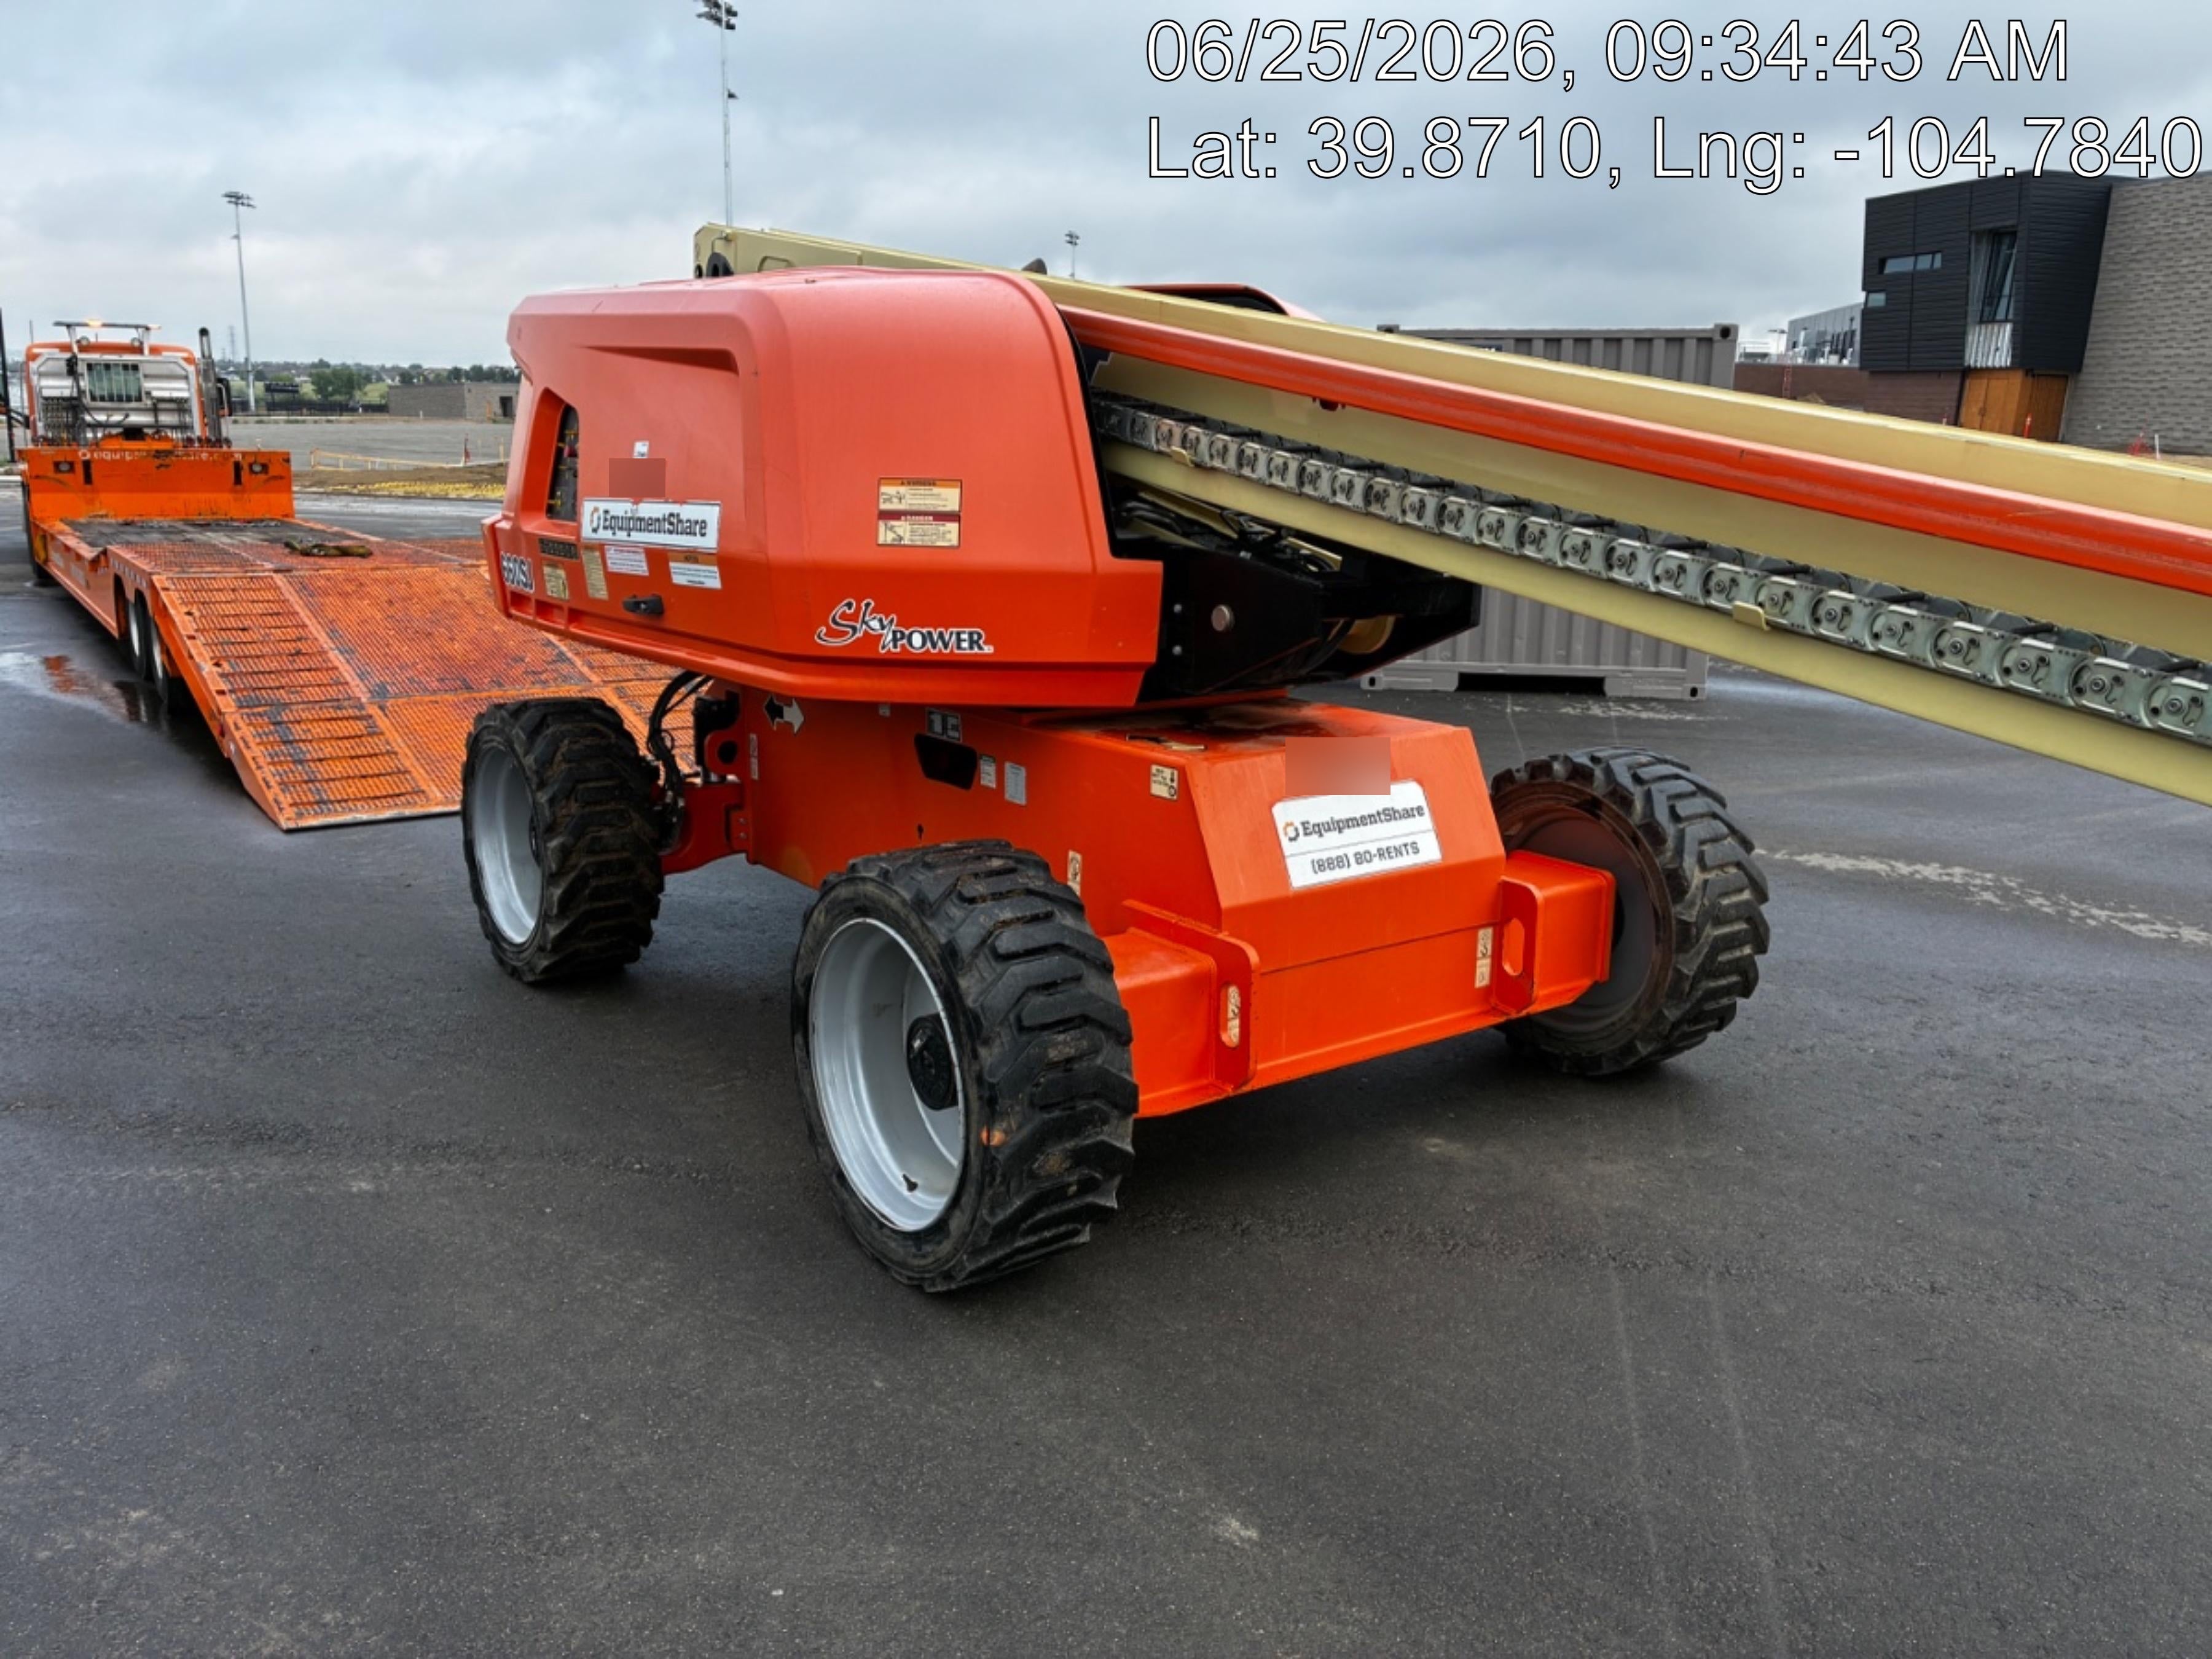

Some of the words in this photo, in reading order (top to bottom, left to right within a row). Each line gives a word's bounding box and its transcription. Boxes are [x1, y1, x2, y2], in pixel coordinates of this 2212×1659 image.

[602, 509, 707, 537] EquipmentShare
[1301, 805, 1425, 837] EquipmentShare
[1311, 853, 1351, 874] (888)
